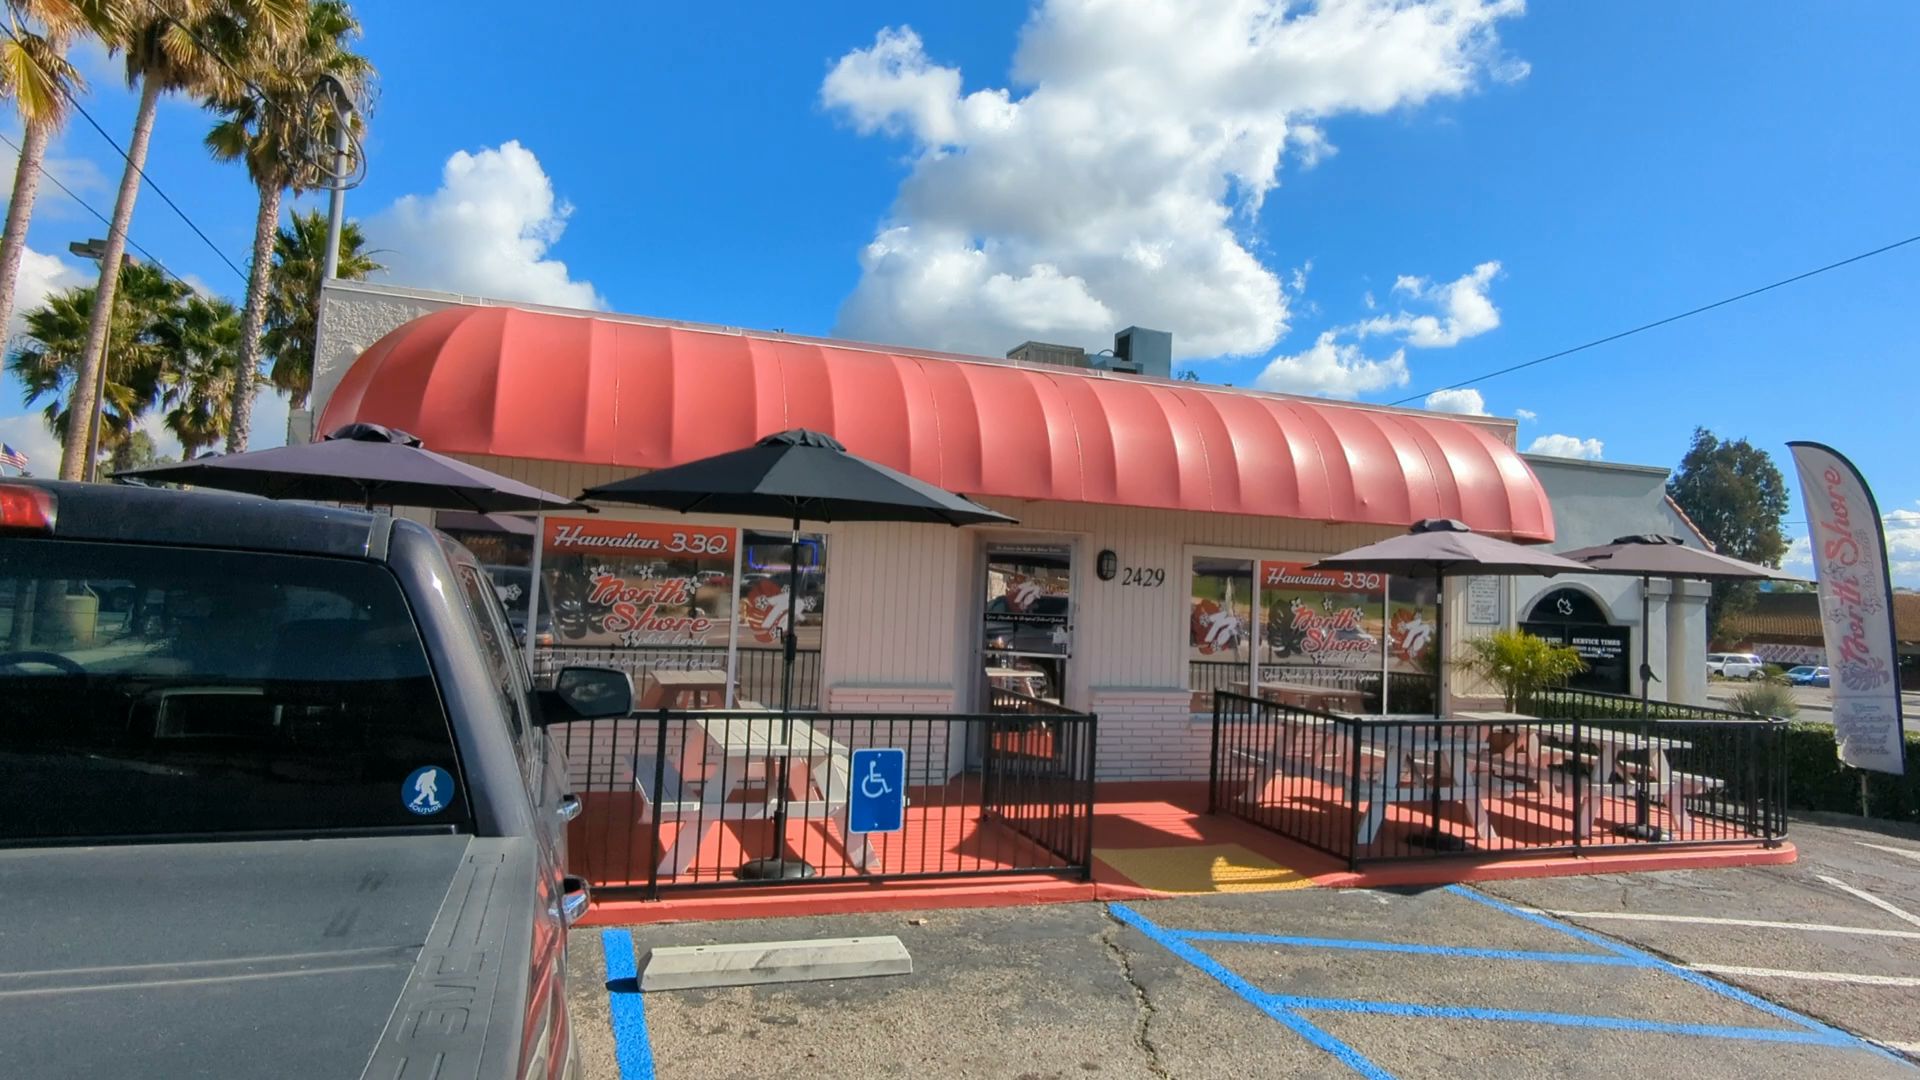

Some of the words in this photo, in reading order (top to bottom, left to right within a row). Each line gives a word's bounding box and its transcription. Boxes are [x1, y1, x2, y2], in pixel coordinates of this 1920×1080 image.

[1821, 466, 1859, 566] Shore
[554, 525, 660, 549] Hawaiian
[588, 573, 688, 605] North
[1121, 567, 1165, 588] 2429
[1267, 567, 1336, 586] Hawaiian
[603, 601, 714, 633] Shore
[1290, 605, 1356, 631] North
[1830, 575, 1869, 665] North
[1301, 628, 1370, 653] Shore
